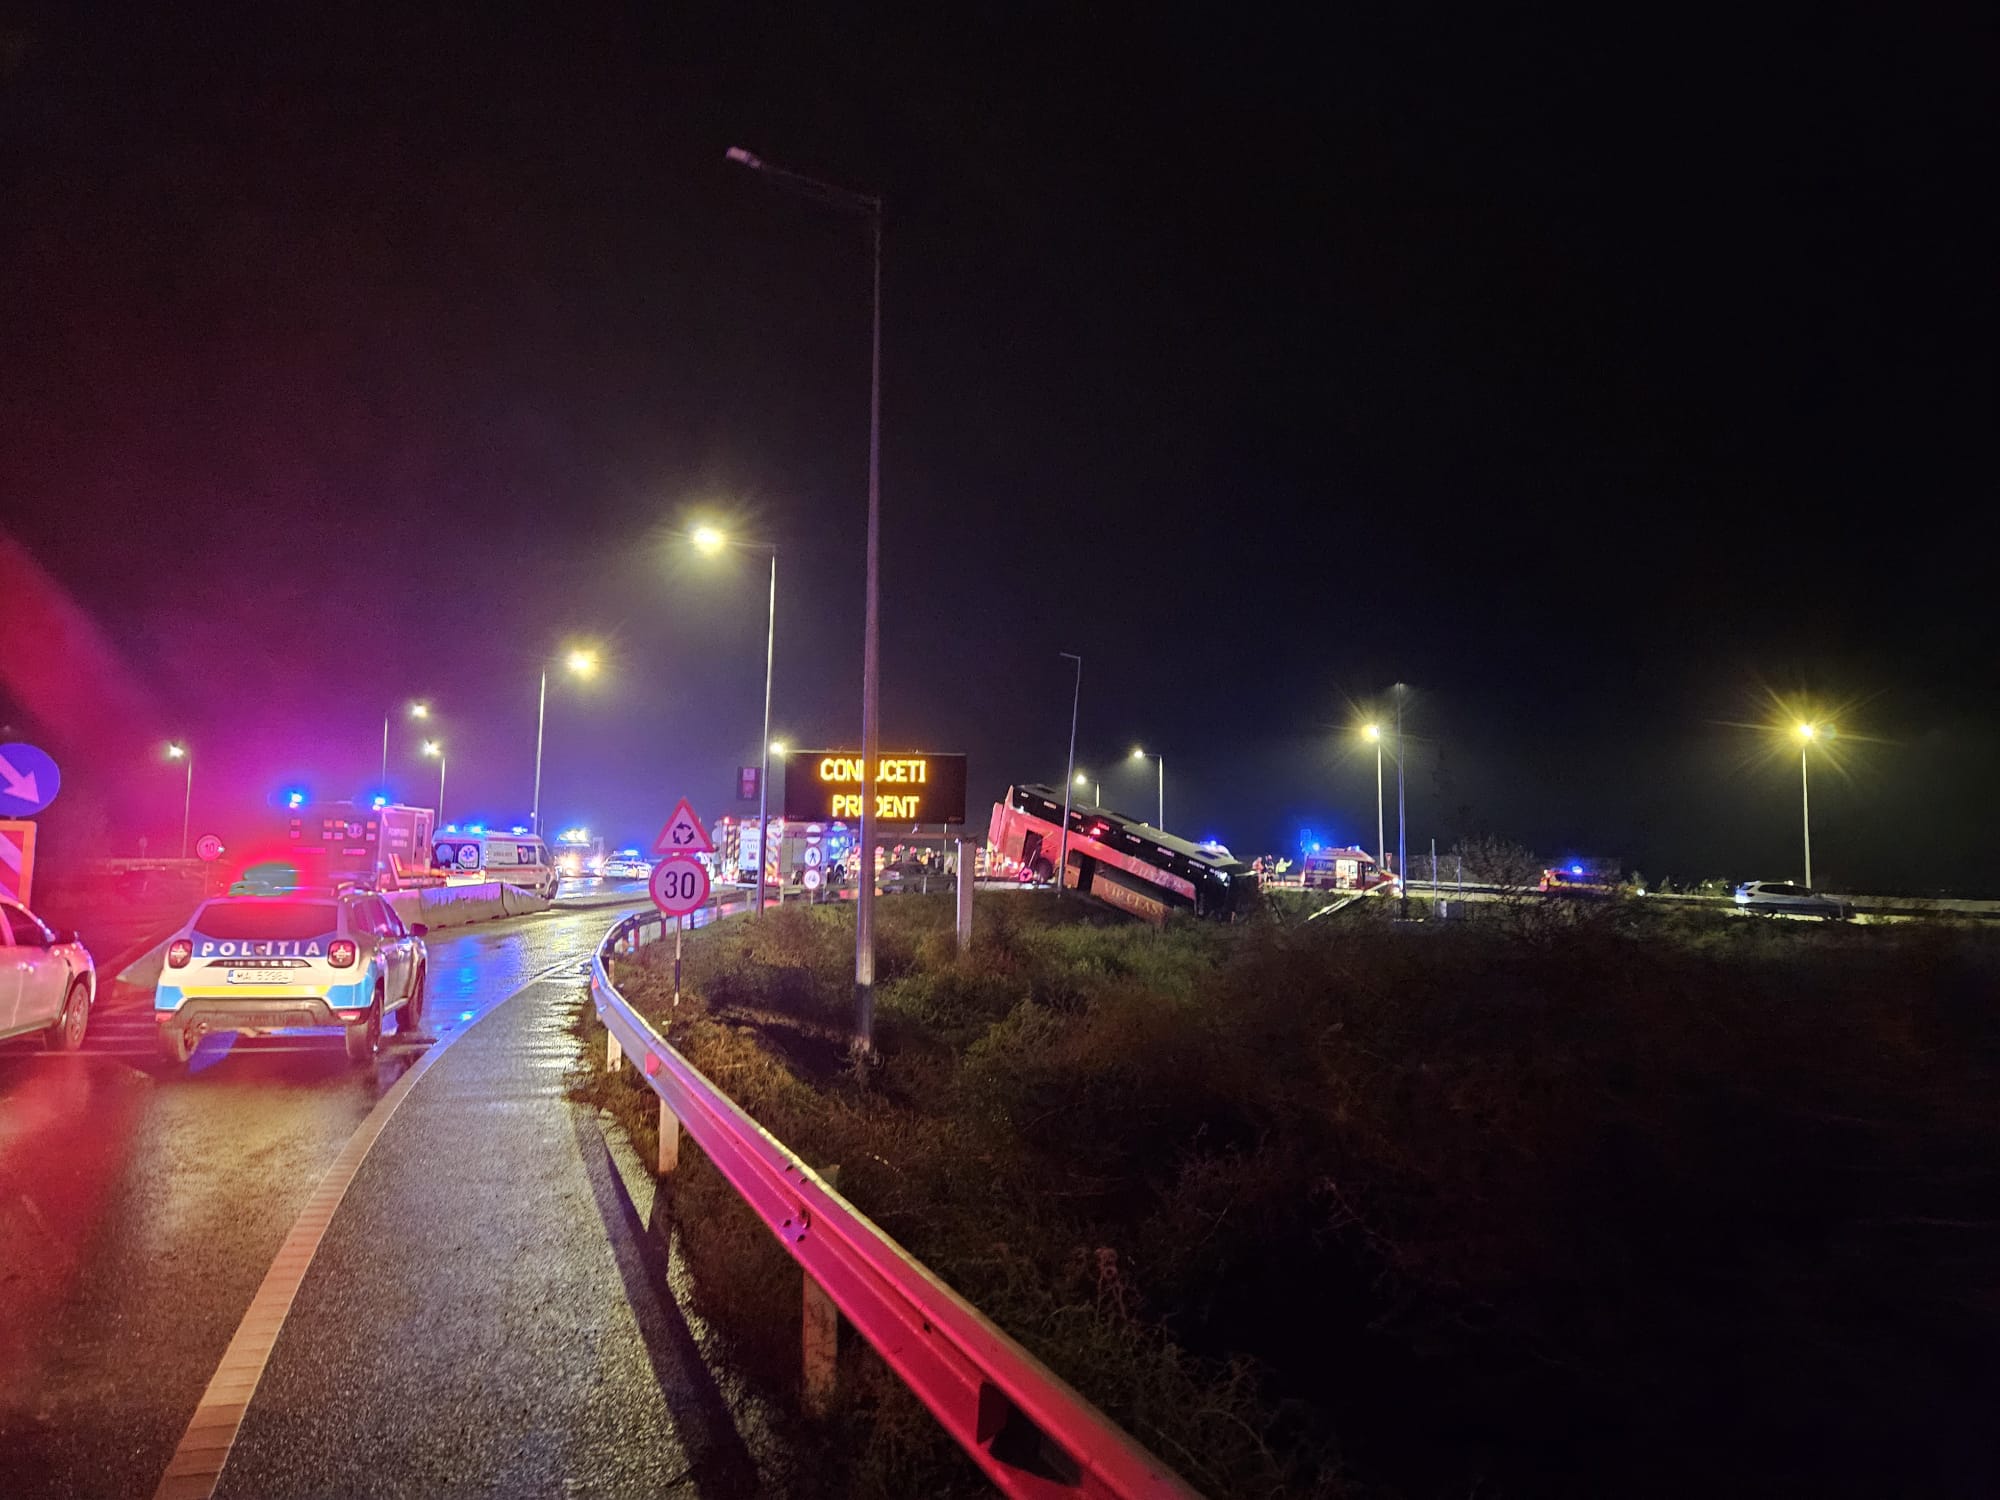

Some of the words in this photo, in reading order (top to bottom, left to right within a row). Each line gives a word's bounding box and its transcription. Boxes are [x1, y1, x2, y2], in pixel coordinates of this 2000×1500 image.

[820, 758, 926, 783] CONUCETI
[832, 794, 920, 818] PRDENT
[664, 870, 695, 900] 30
[1104, 882, 1125, 899] VIP
